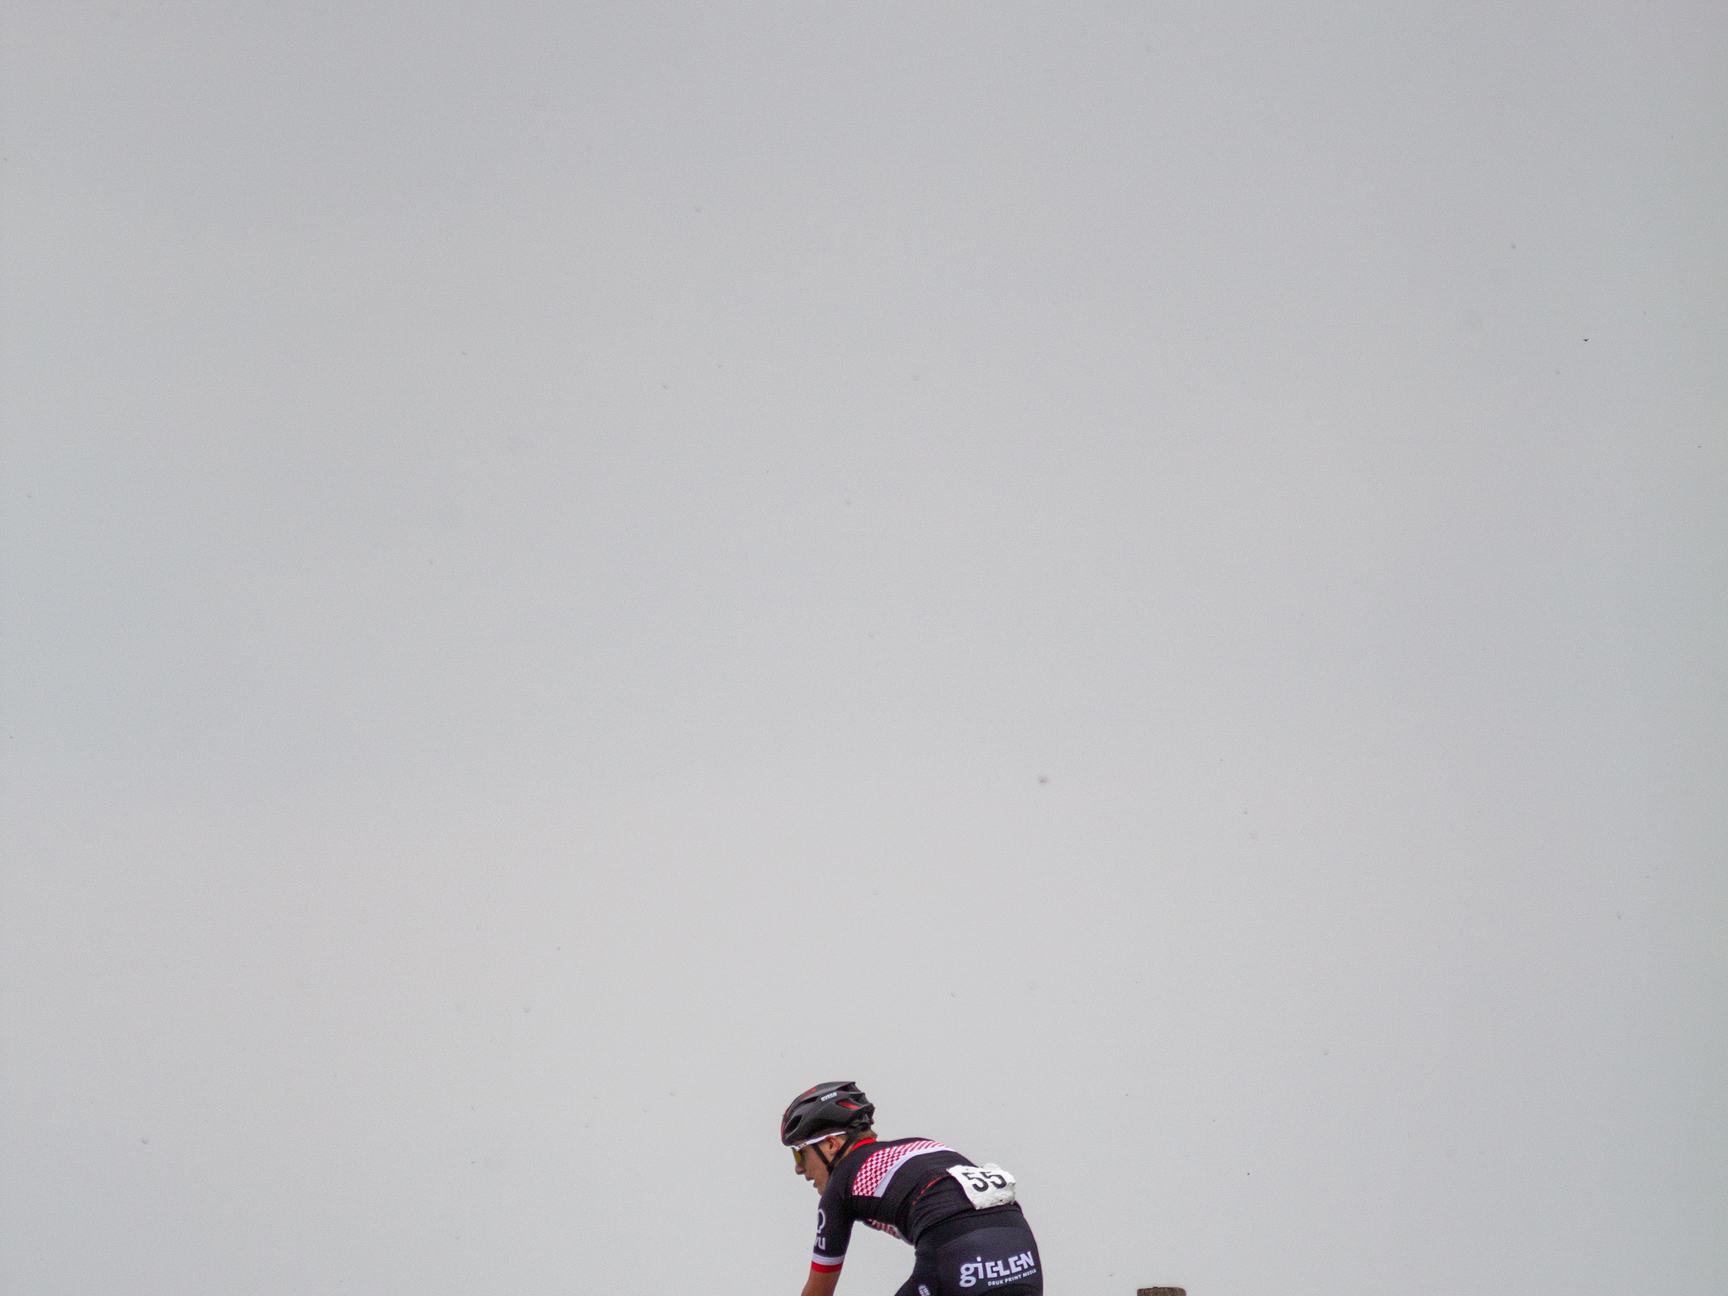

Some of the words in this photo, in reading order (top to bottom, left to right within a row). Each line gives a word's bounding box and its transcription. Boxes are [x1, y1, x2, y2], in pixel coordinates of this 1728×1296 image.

[961, 1171, 1007, 1192] 55
[987, 1279, 1004, 1287] DRUK
[1004, 1274, 1022, 1284] PRINT
[1022, 1268, 1037, 1278] MEDIA
